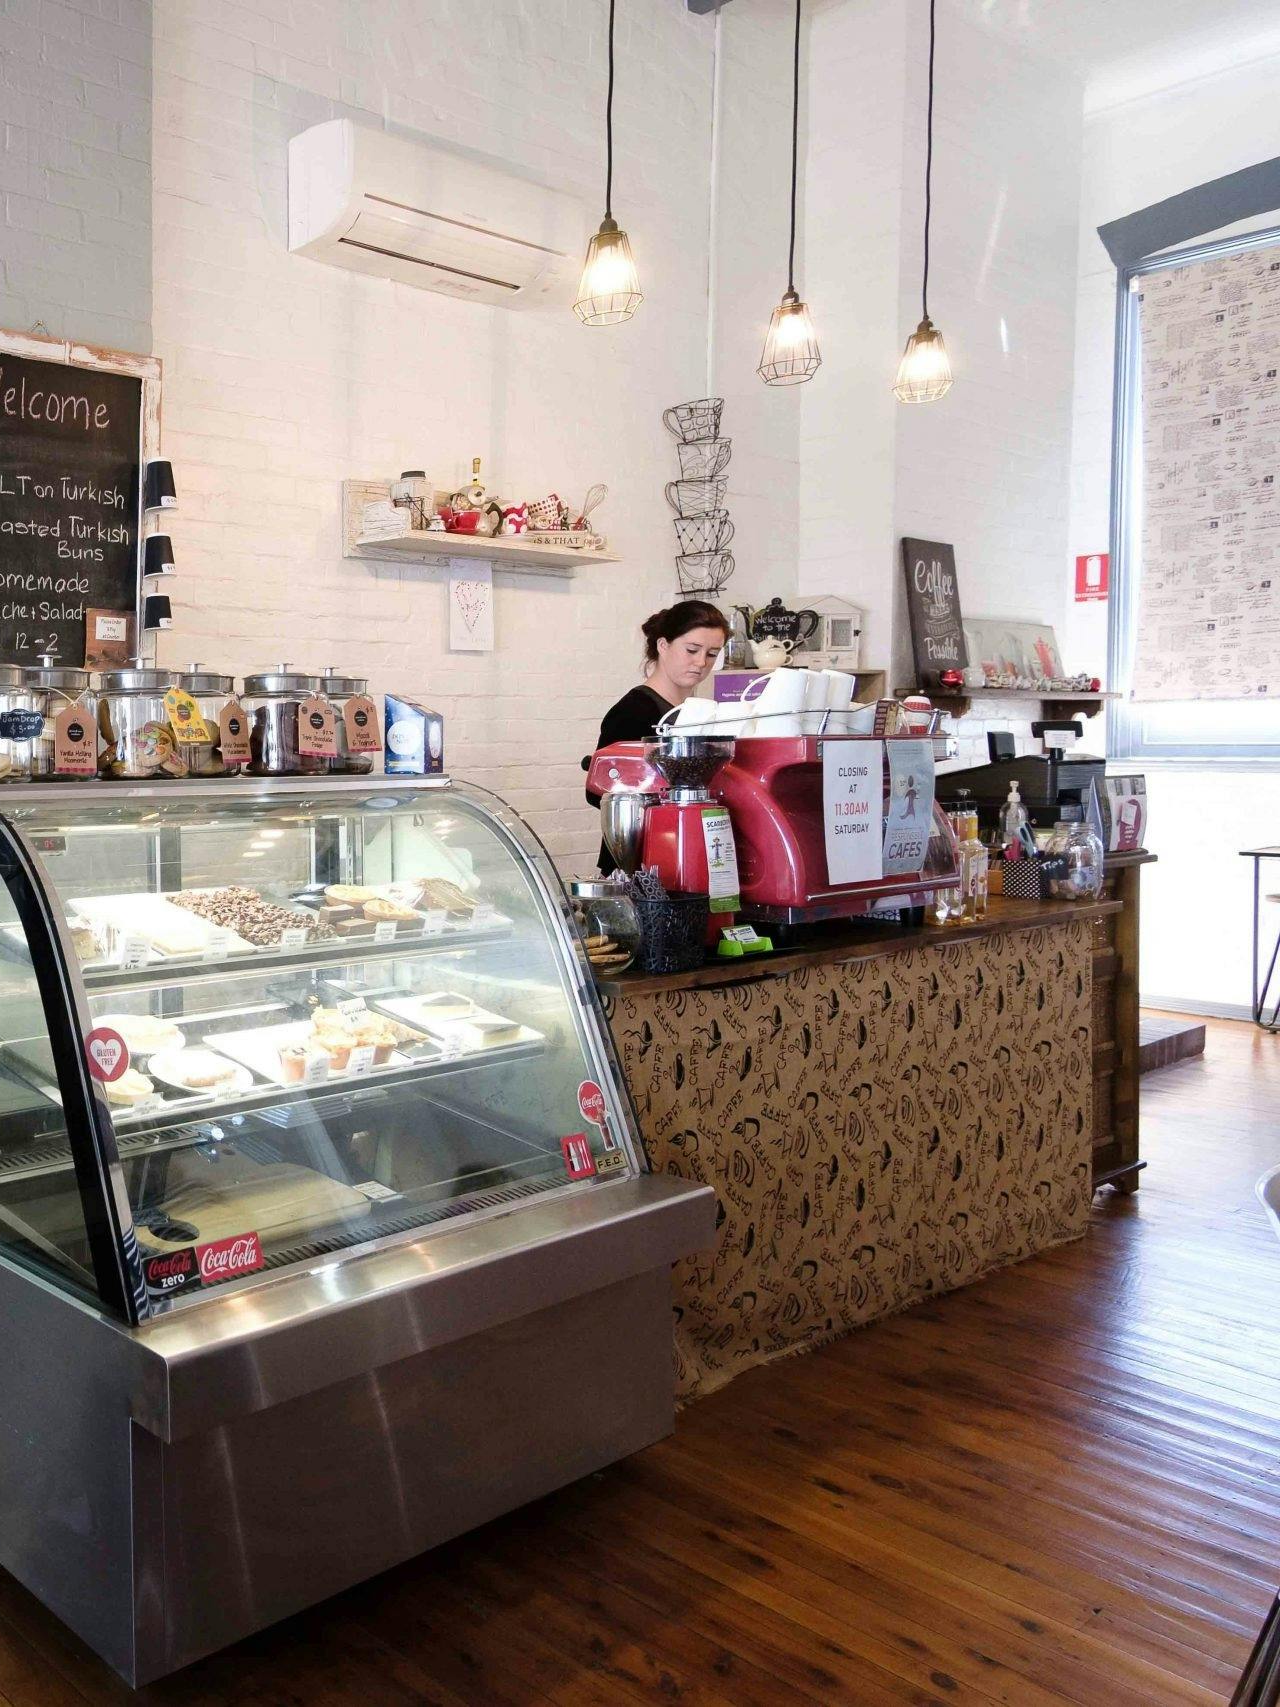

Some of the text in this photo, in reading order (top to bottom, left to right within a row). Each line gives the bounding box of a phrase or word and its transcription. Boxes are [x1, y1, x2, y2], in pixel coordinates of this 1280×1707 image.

[34, 484, 54, 498] on
[60, 477, 125, 509] Turkish
[69, 515, 129, 545] Turkish
[57, 540, 104, 562] Buns
[914, 560, 954, 602] Coffee
[39, 601, 83, 621] Salad
[924, 637, 959, 661] Possible
[838, 767, 868, 777] CLOSING
[848, 784, 857, 794] AT
[834, 802, 869, 816] 11.30AM
[834, 823, 869, 835] SATURDAY
[888, 841, 923, 859] CAFES
[815, 1004, 826, 1050] CAFFE
[97, 1049, 115, 1057] GLUTEN
[689, 1038, 703, 1086] CAFFE
[776, 1023, 792, 1070] CAFFE
[650, 1044, 664, 1094] CAFFE
[715, 1042, 734, 1089] CAFFE
[718, 1089, 744, 1129] CAFFE
[598, 1157, 623, 1168] F.E.D.
[891, 1158, 904, 1202] CAFFE
[814, 1173, 824, 1218] CAFFE
[835, 1174, 849, 1219] CAFFE
[201, 1237, 257, 1276] Coca-Cola
[716, 1220, 737, 1267] CAFFE
[162, 1273, 185, 1288] zero
[717, 1266, 745, 1305] CAFFE
